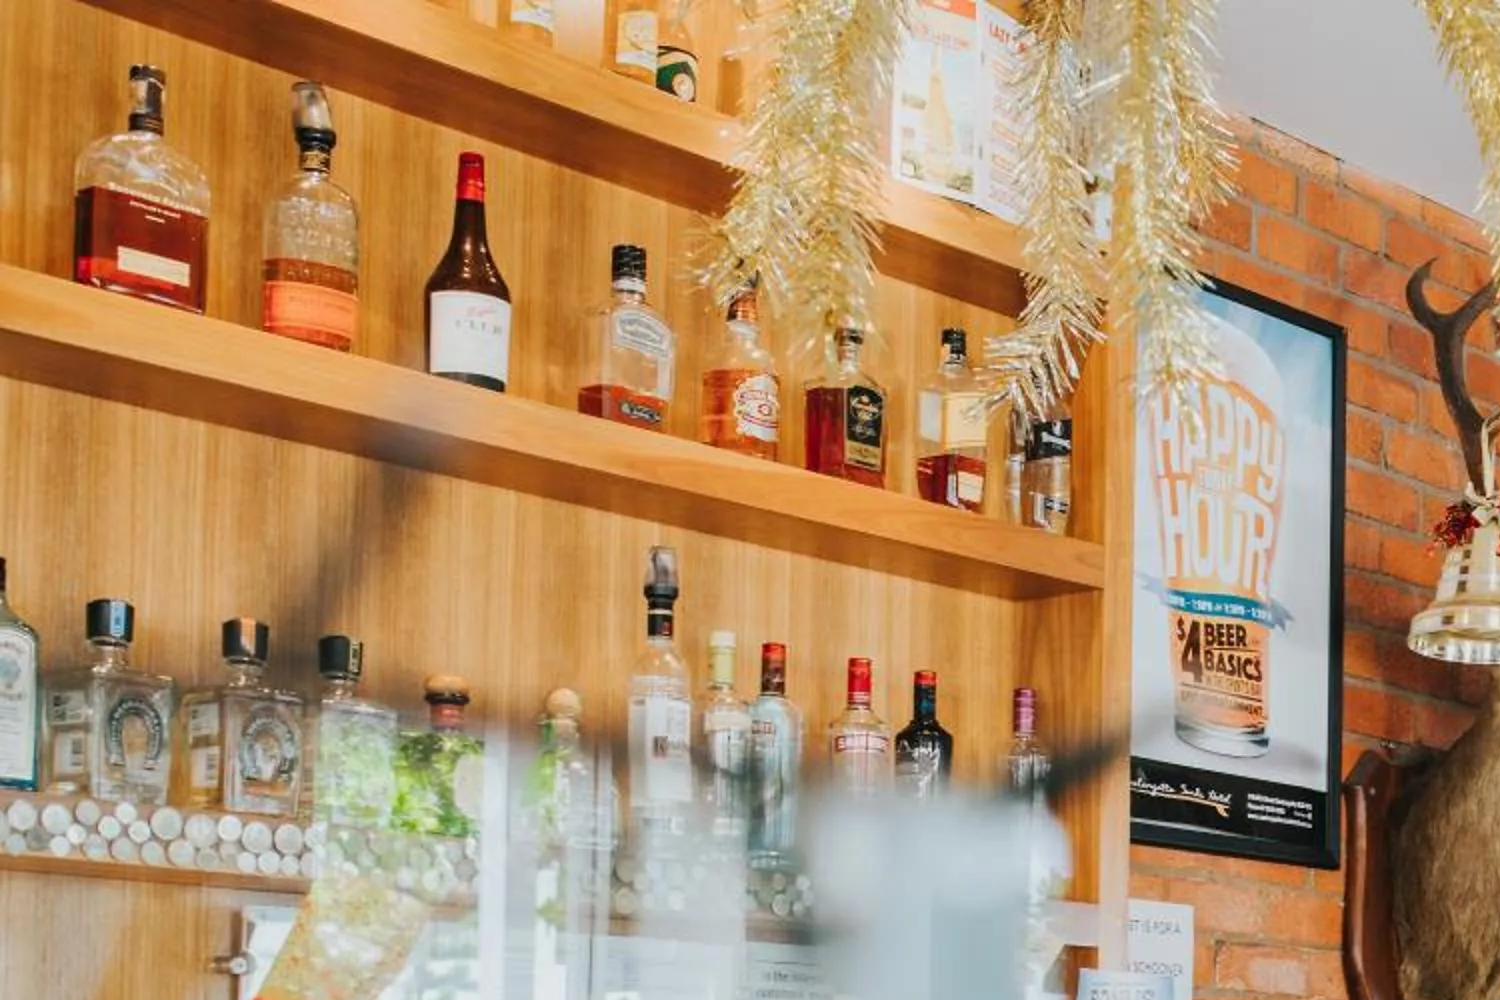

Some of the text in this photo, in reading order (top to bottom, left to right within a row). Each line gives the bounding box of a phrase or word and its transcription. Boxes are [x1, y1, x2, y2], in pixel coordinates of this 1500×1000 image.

[1152, 376, 1284, 503] HAPPY
[1158, 476, 1275, 596] HOUR
[1203, 622, 1247, 648] BEER
[1203, 648, 1263, 683] BASICS
